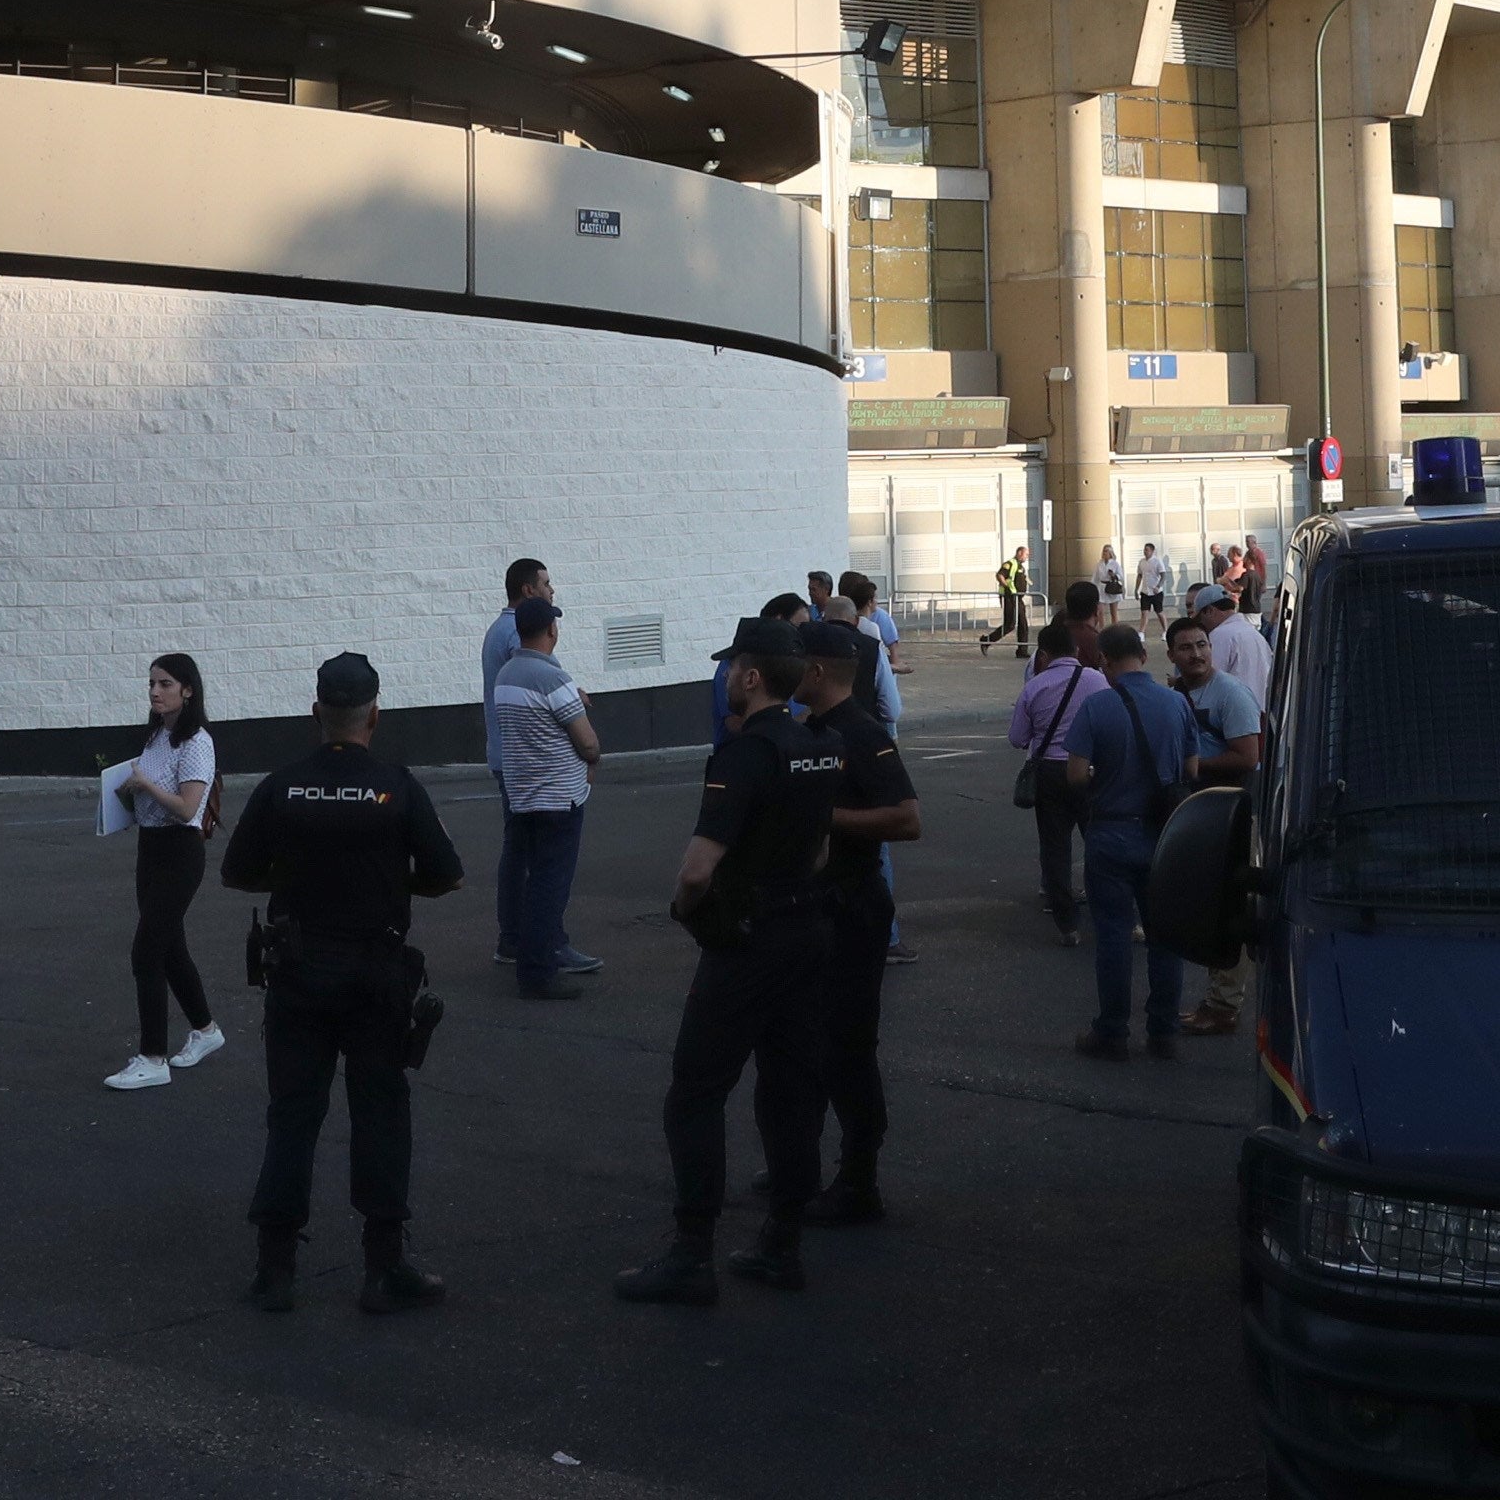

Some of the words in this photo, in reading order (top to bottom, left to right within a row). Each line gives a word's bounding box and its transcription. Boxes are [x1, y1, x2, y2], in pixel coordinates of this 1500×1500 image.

[590, 211, 609, 219] PASEO
[580, 222, 618, 235] CASTELLANA
[1144, 356, 1160, 376] 11
[790, 756, 840, 773] POLICIA
[287, 787, 377, 801] POLICIA
